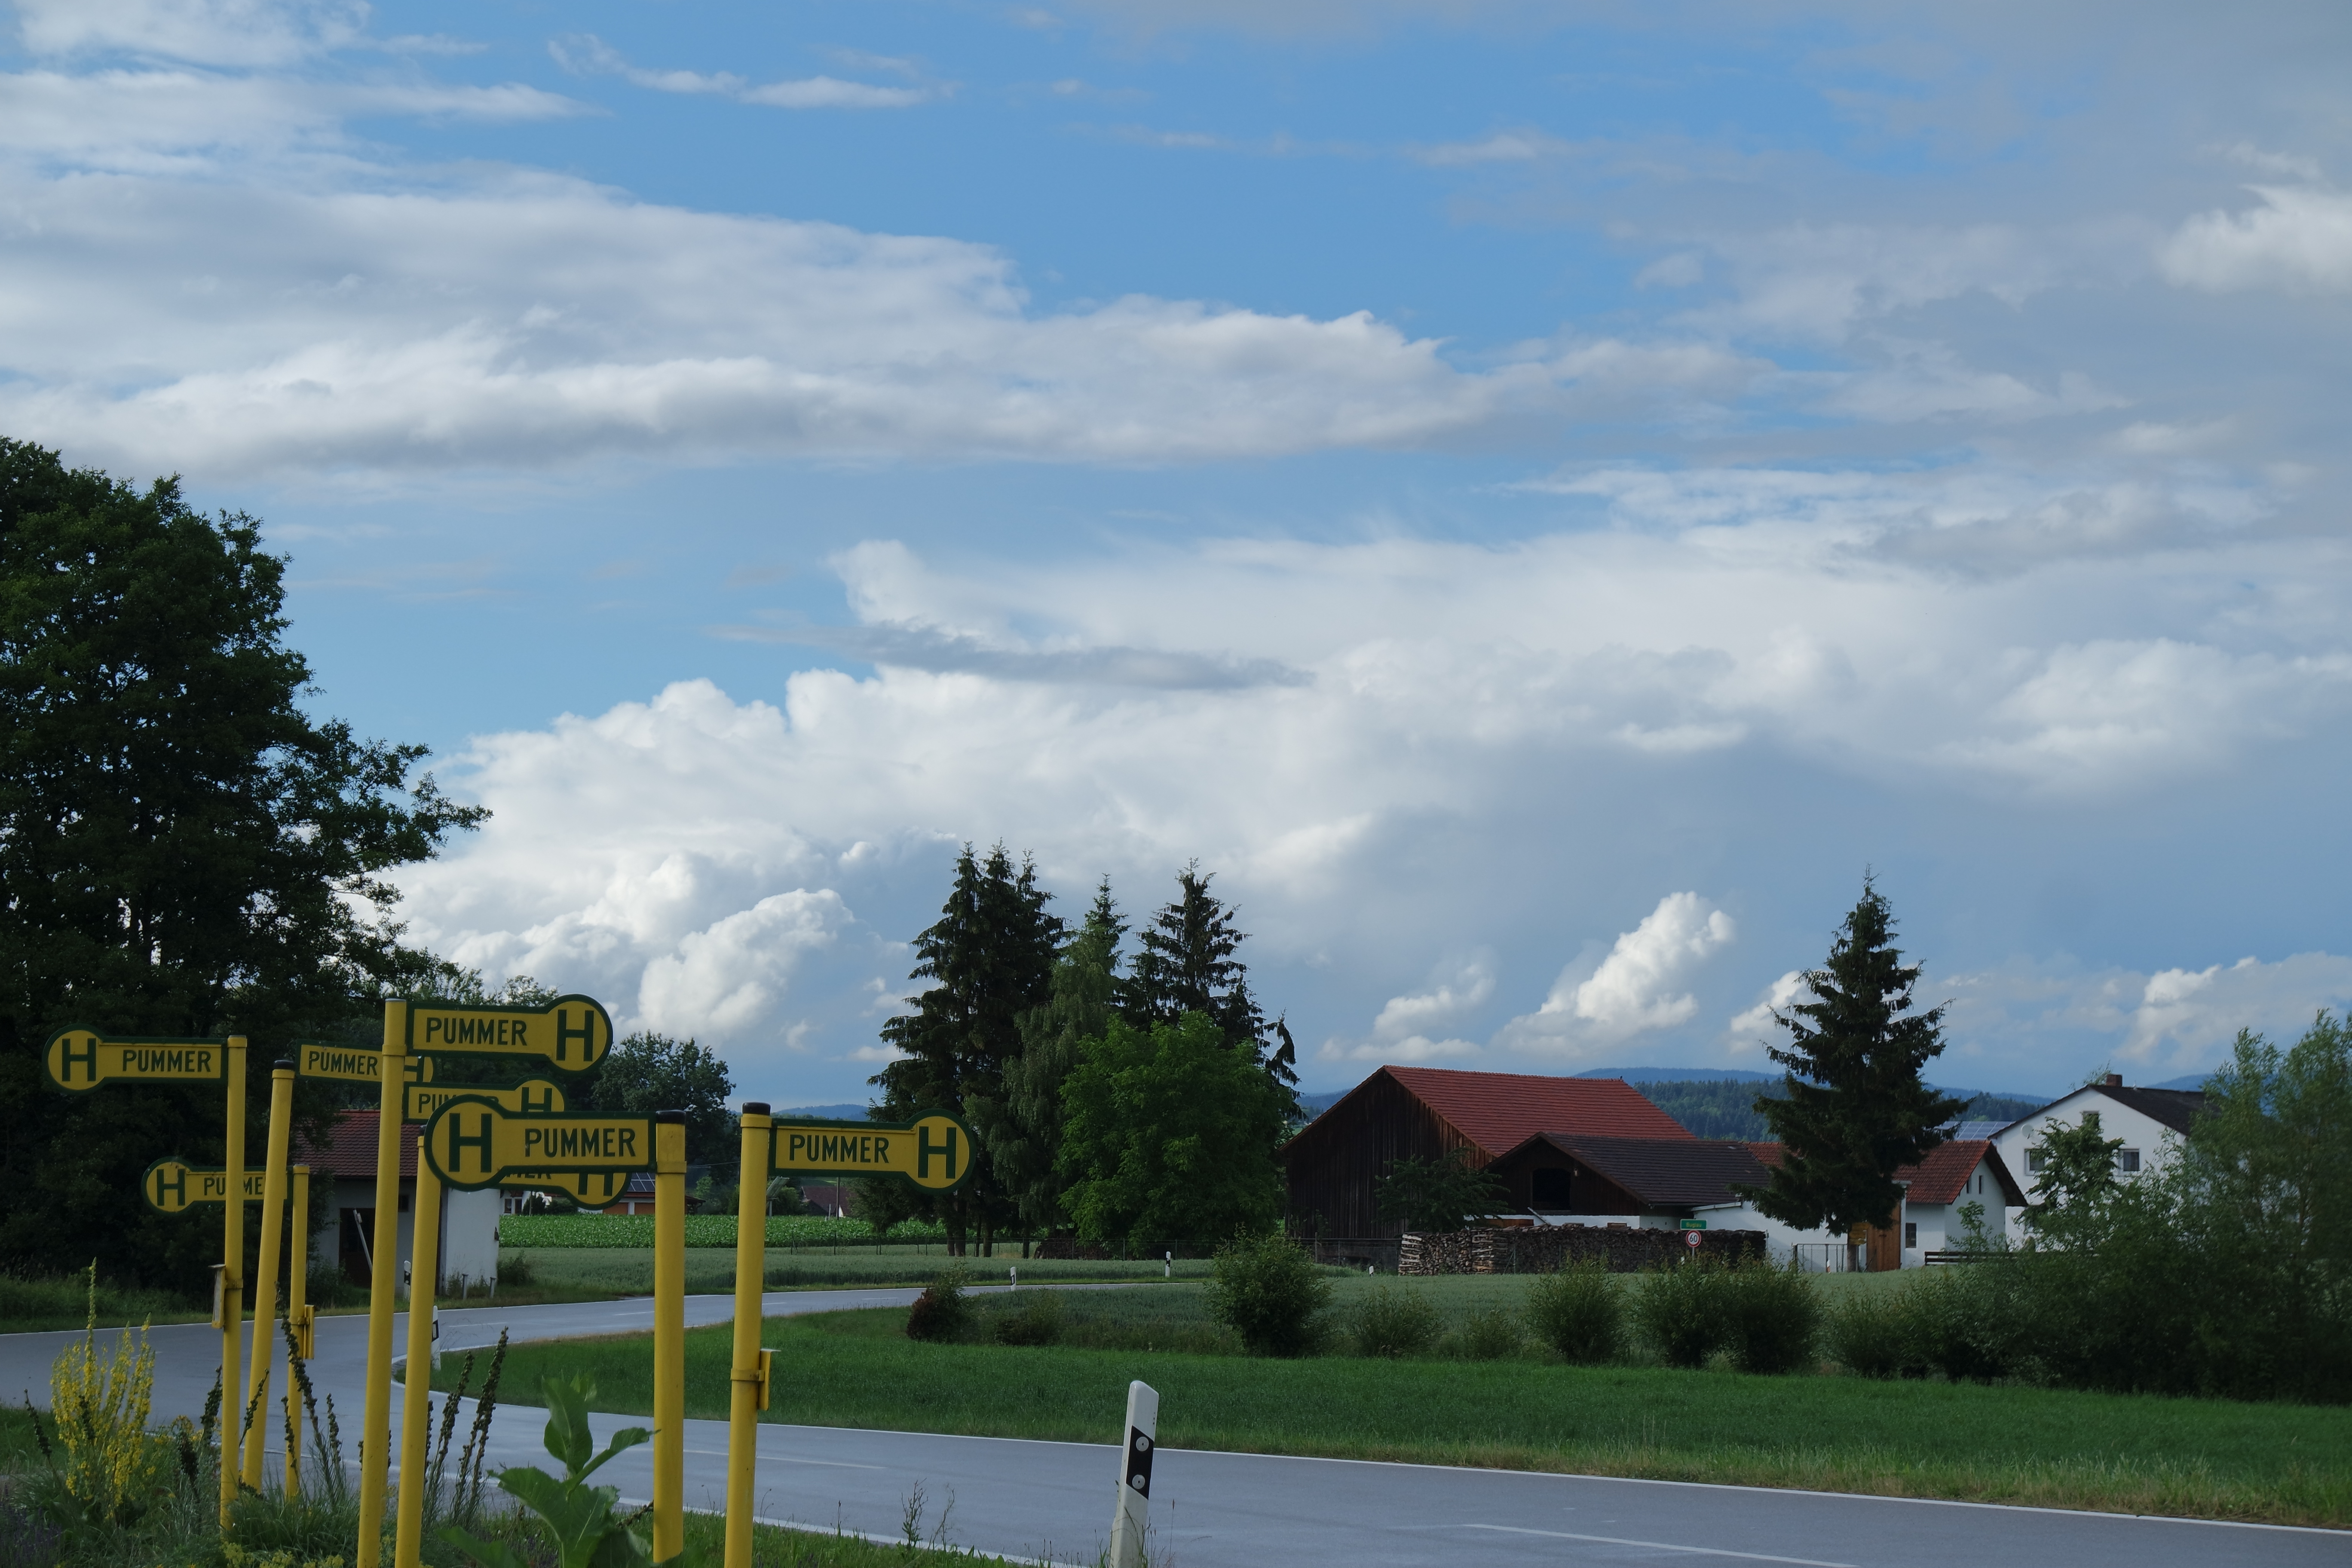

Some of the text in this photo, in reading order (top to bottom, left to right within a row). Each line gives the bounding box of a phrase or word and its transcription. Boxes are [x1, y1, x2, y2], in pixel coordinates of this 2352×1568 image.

[61, 1038, 211, 1081] H PUMMER
[426, 1009, 594, 1062] PUMMER H
[308, 1050, 378, 1075] PUMMER
[448, 1112, 636, 1173] H PUMMER
[789, 1126, 957, 1179] PUMMER H
[156, 1168, 263, 1206] H PUME
